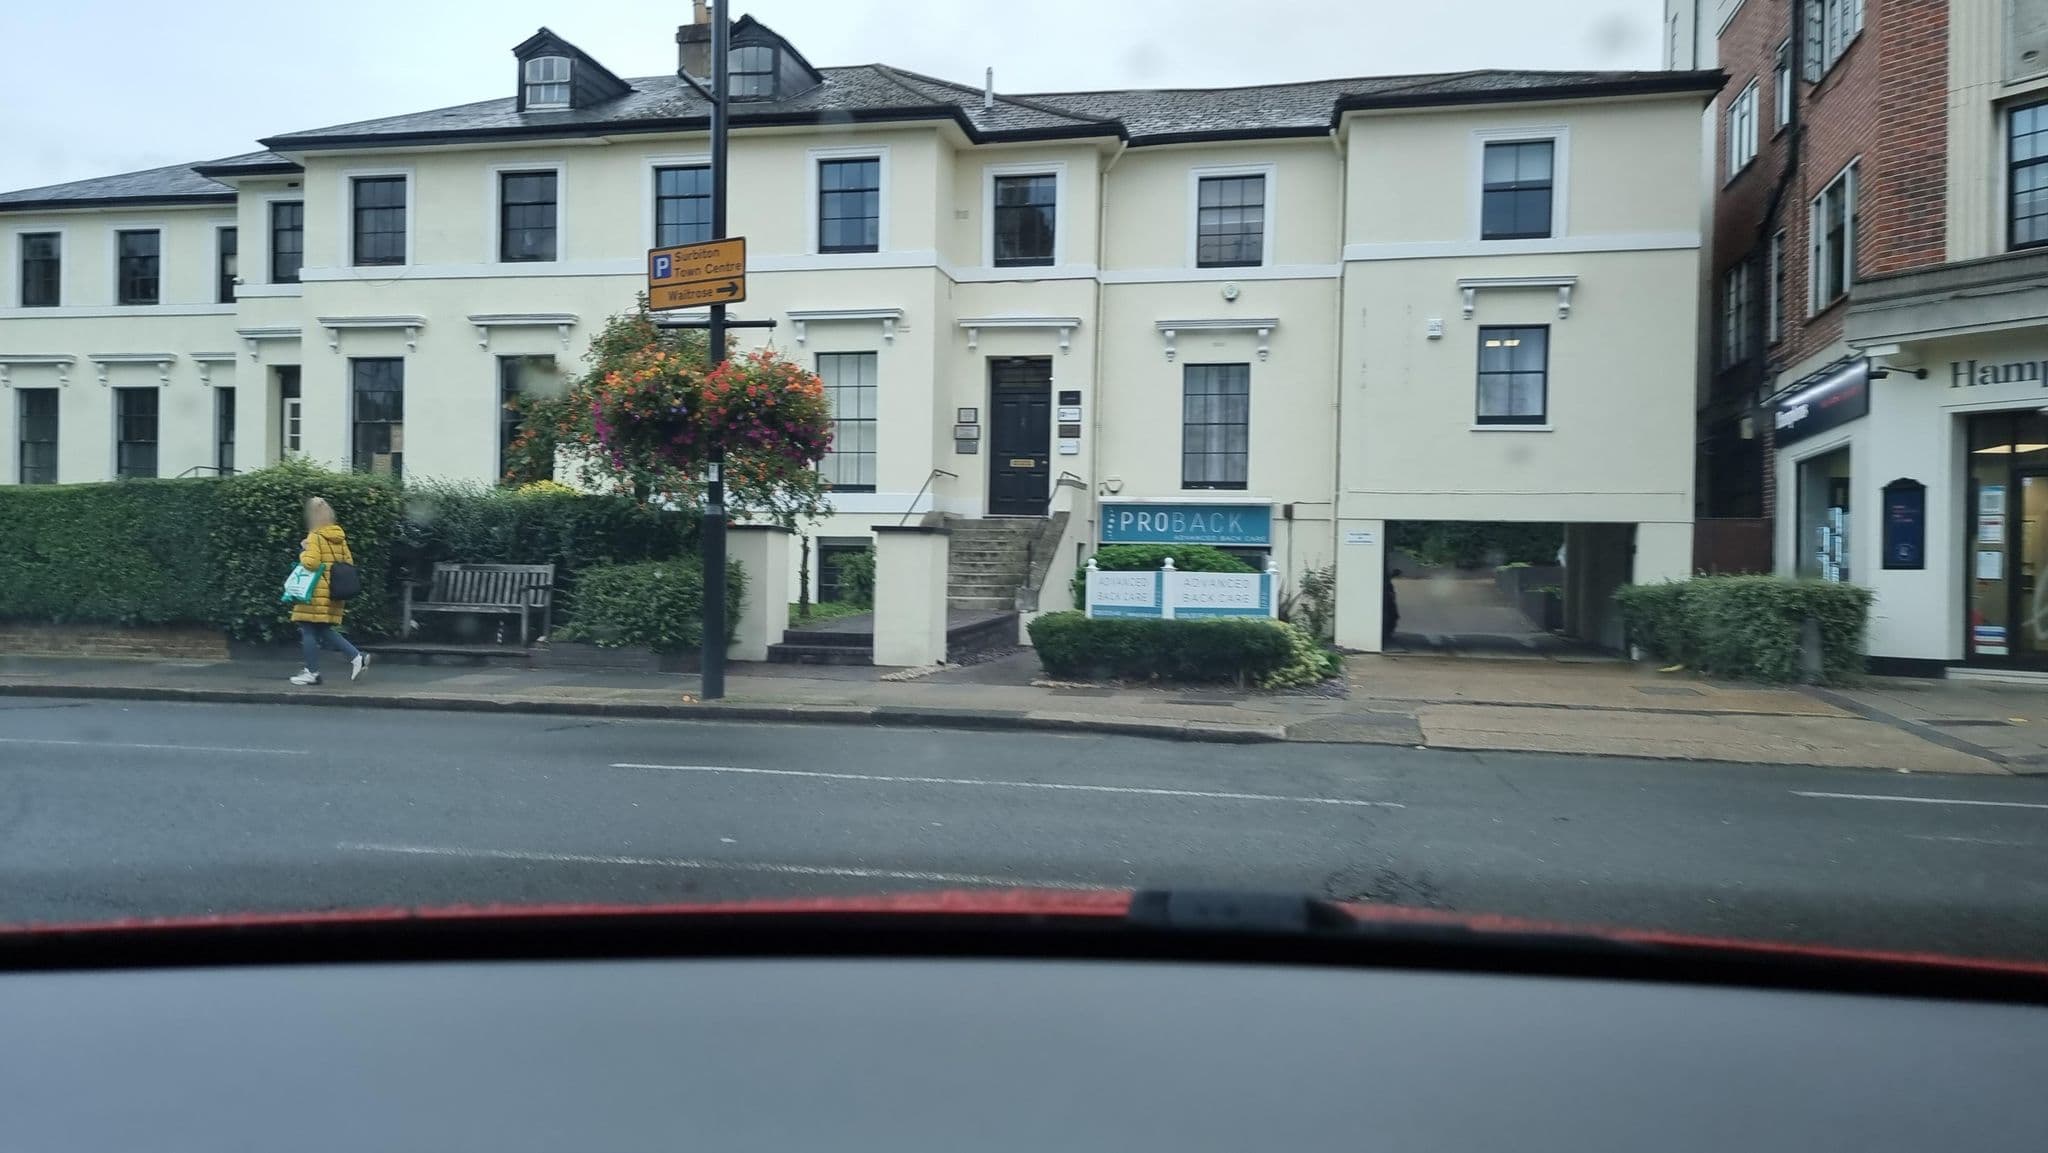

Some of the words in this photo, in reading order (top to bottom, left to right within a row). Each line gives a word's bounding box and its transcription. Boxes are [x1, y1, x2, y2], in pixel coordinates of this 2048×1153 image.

[674, 248, 720, 262] Surbiton
[656, 257, 669, 277] P
[674, 267, 702, 277] Town
[704, 262, 742, 274] Centre
[668, 288, 713, 300] Waitrose
[1120, 511, 1243, 533] PROBACK
[1099, 576, 1147, 588] ADVANCED
[1184, 576, 1249, 589] ADVANCED
[1097, 591, 1120, 601] BACK
[1123, 591, 1147, 602] CARE
[1183, 593, 1214, 603] BACK
[1220, 593, 1249, 604] CARE
